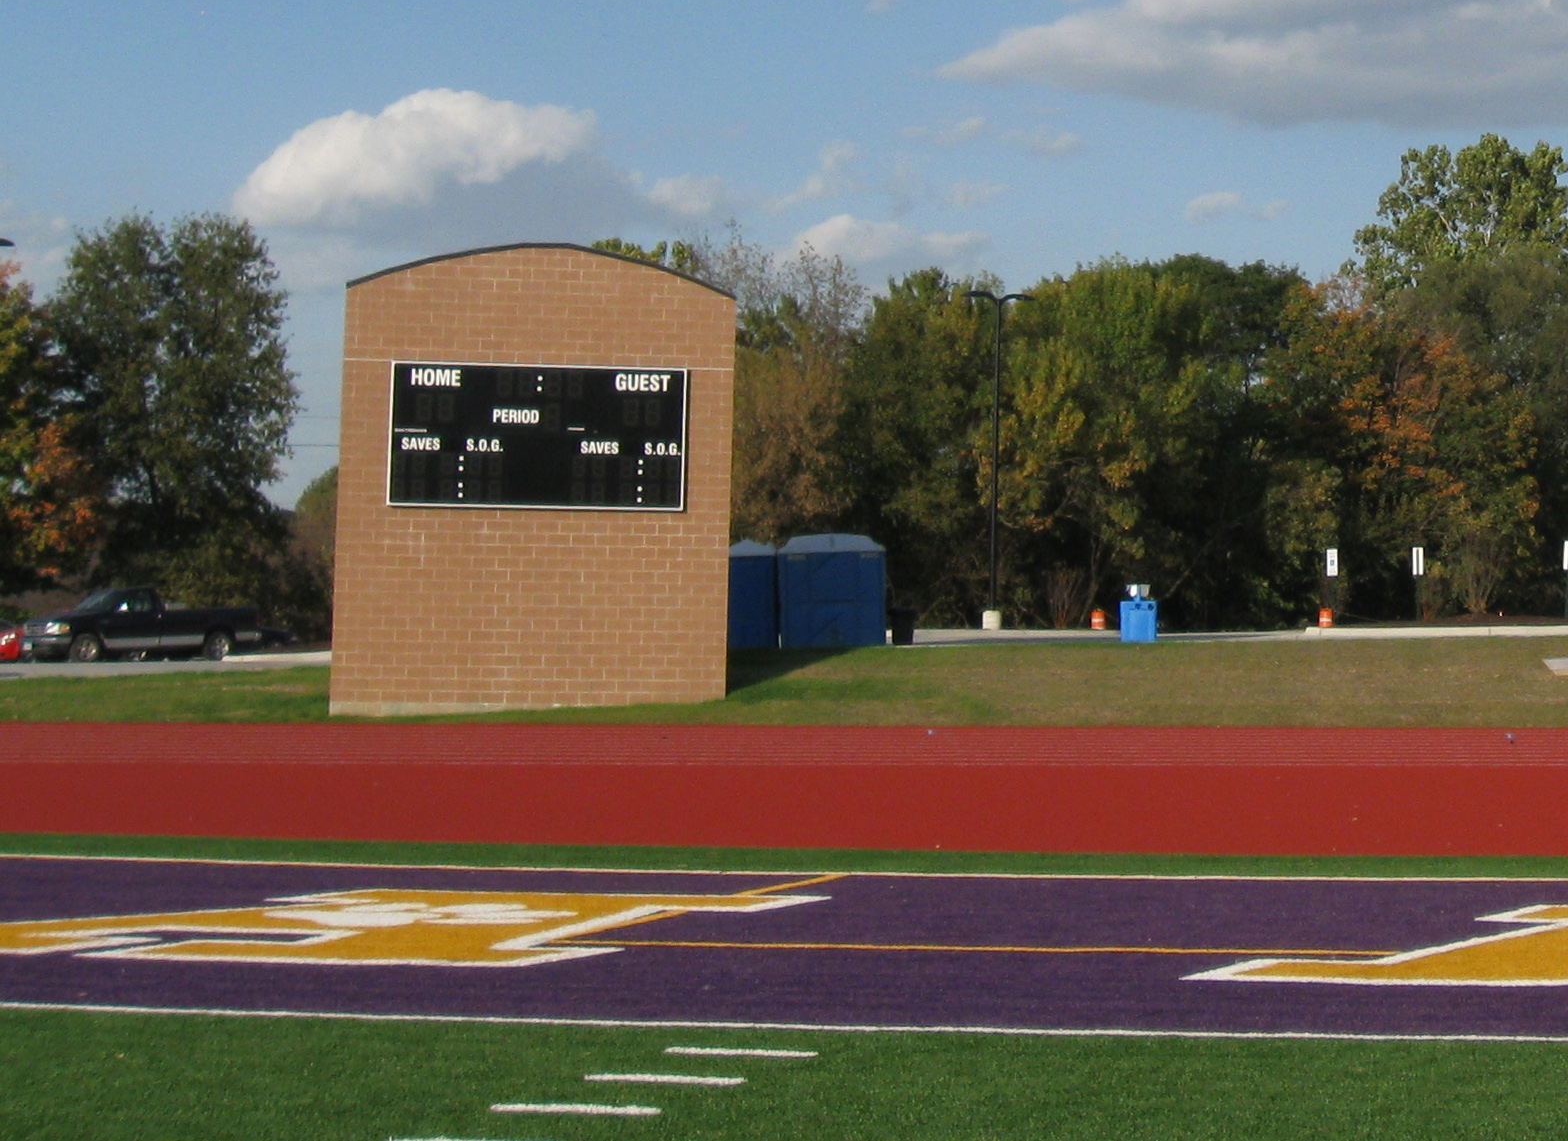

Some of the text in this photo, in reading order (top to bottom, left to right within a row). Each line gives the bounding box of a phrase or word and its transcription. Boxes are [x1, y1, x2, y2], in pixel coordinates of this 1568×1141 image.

[410, 368, 461, 387] HOME
[615, 373, 671, 392] GUEST
[492, 408, 540, 424] PERIOD
[401, 436, 504, 452] SAVES S.O.G.
[580, 440, 681, 456] SAVES S.O.G.
